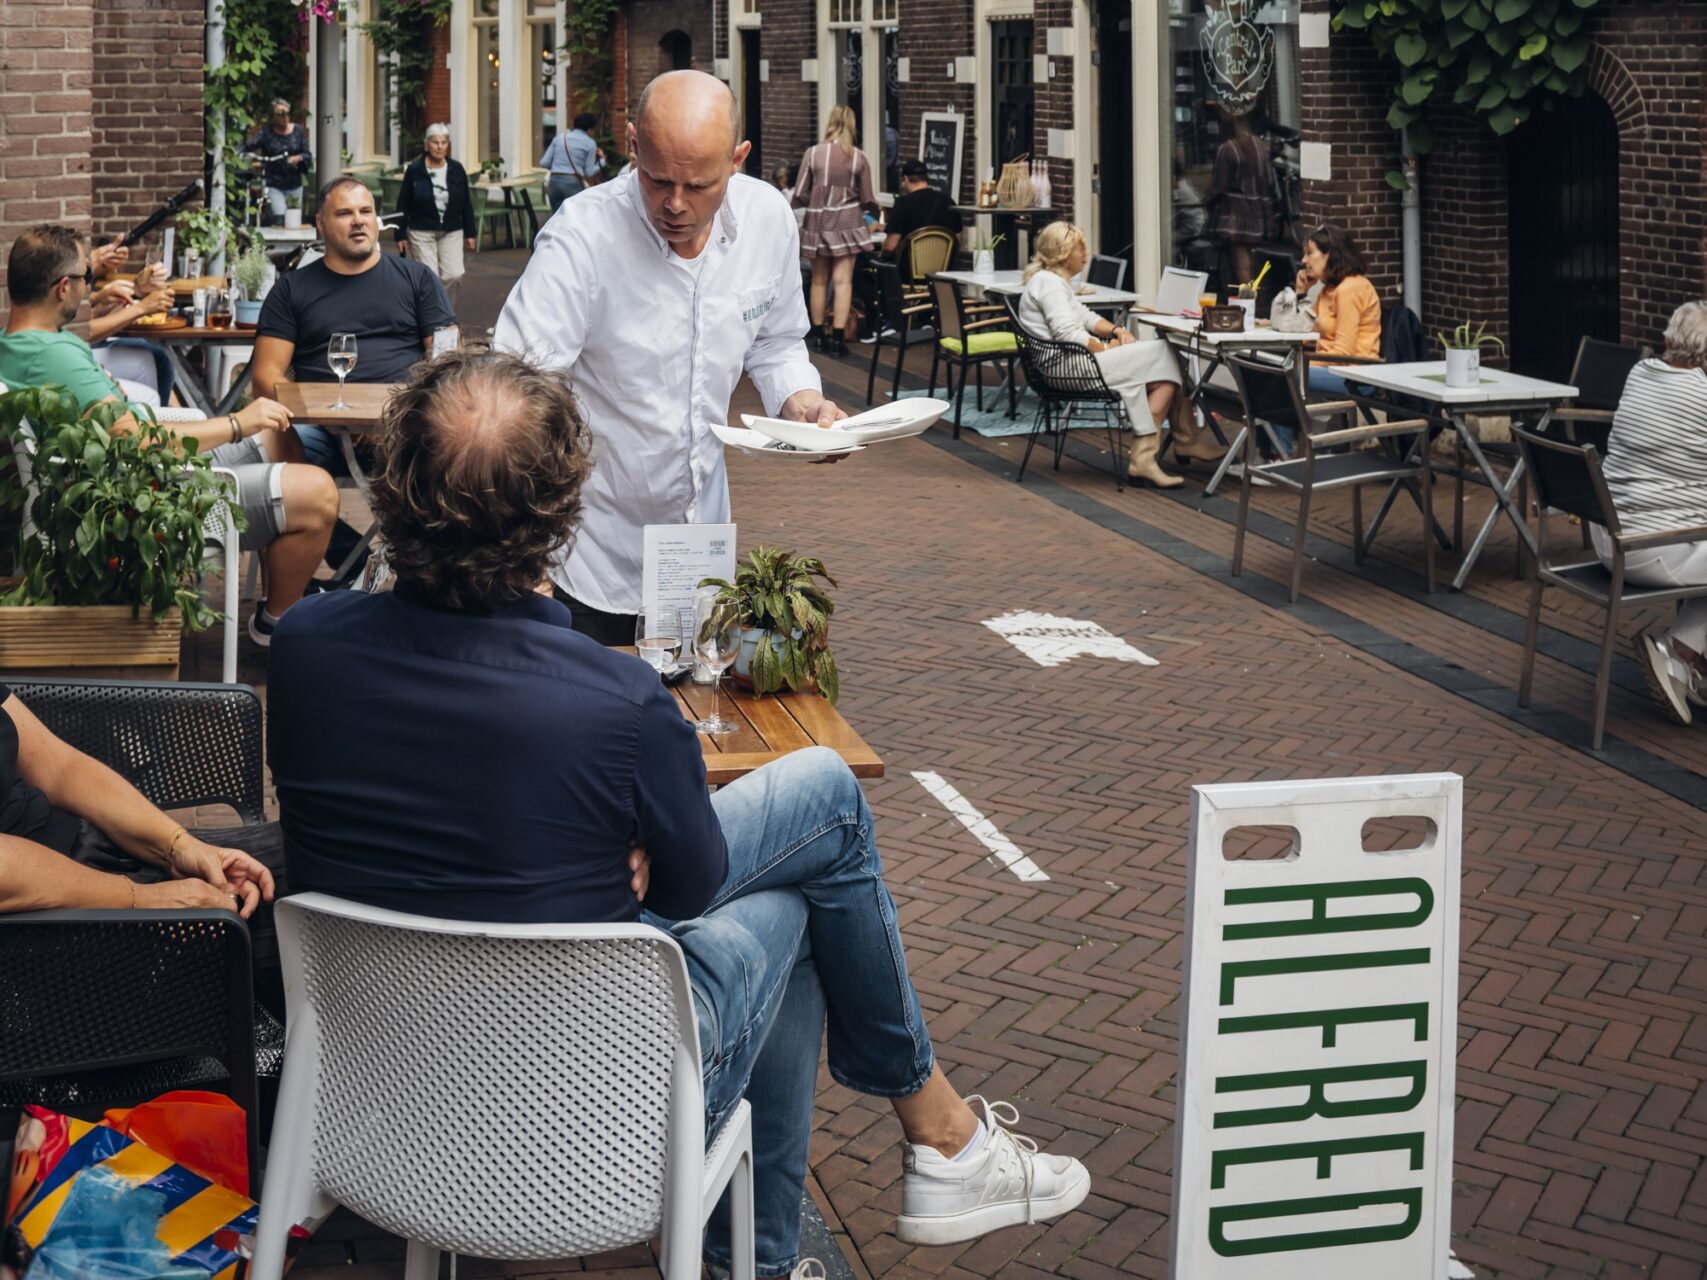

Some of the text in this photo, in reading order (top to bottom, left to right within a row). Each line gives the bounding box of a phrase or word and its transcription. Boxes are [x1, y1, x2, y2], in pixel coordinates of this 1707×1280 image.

[1218, 28, 1254, 58] Central
[1225, 53, 1249, 75] Park
[1208, 876, 1435, 1258] ALFRED
